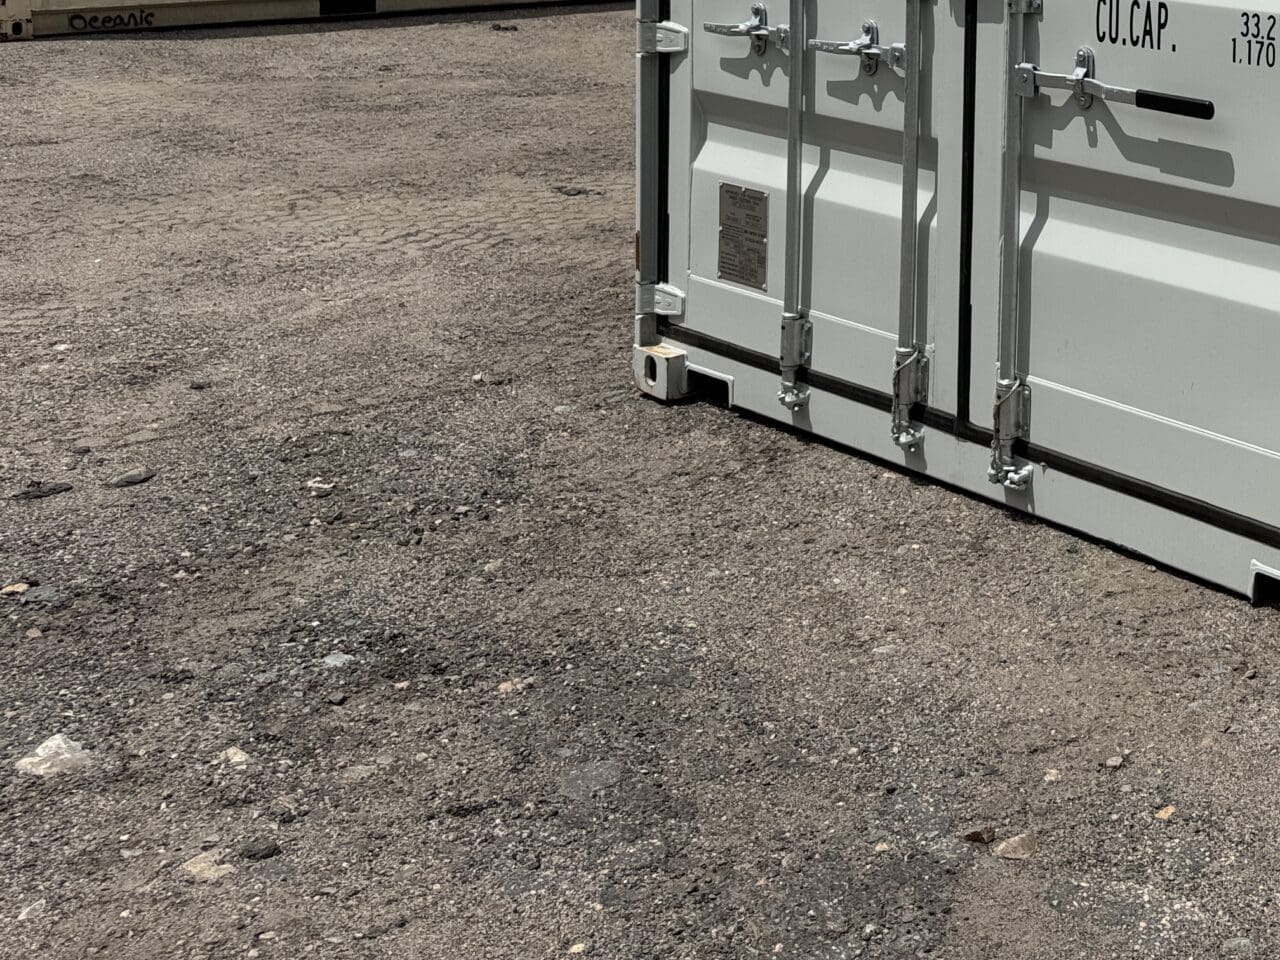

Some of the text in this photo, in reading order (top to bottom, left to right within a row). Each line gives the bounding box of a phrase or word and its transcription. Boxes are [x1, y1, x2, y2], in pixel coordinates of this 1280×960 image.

[69, 9, 155, 31] Oceanic
[1240, 11, 1276, 41] 33.2
[1231, 37, 1276, 68] 1,170
